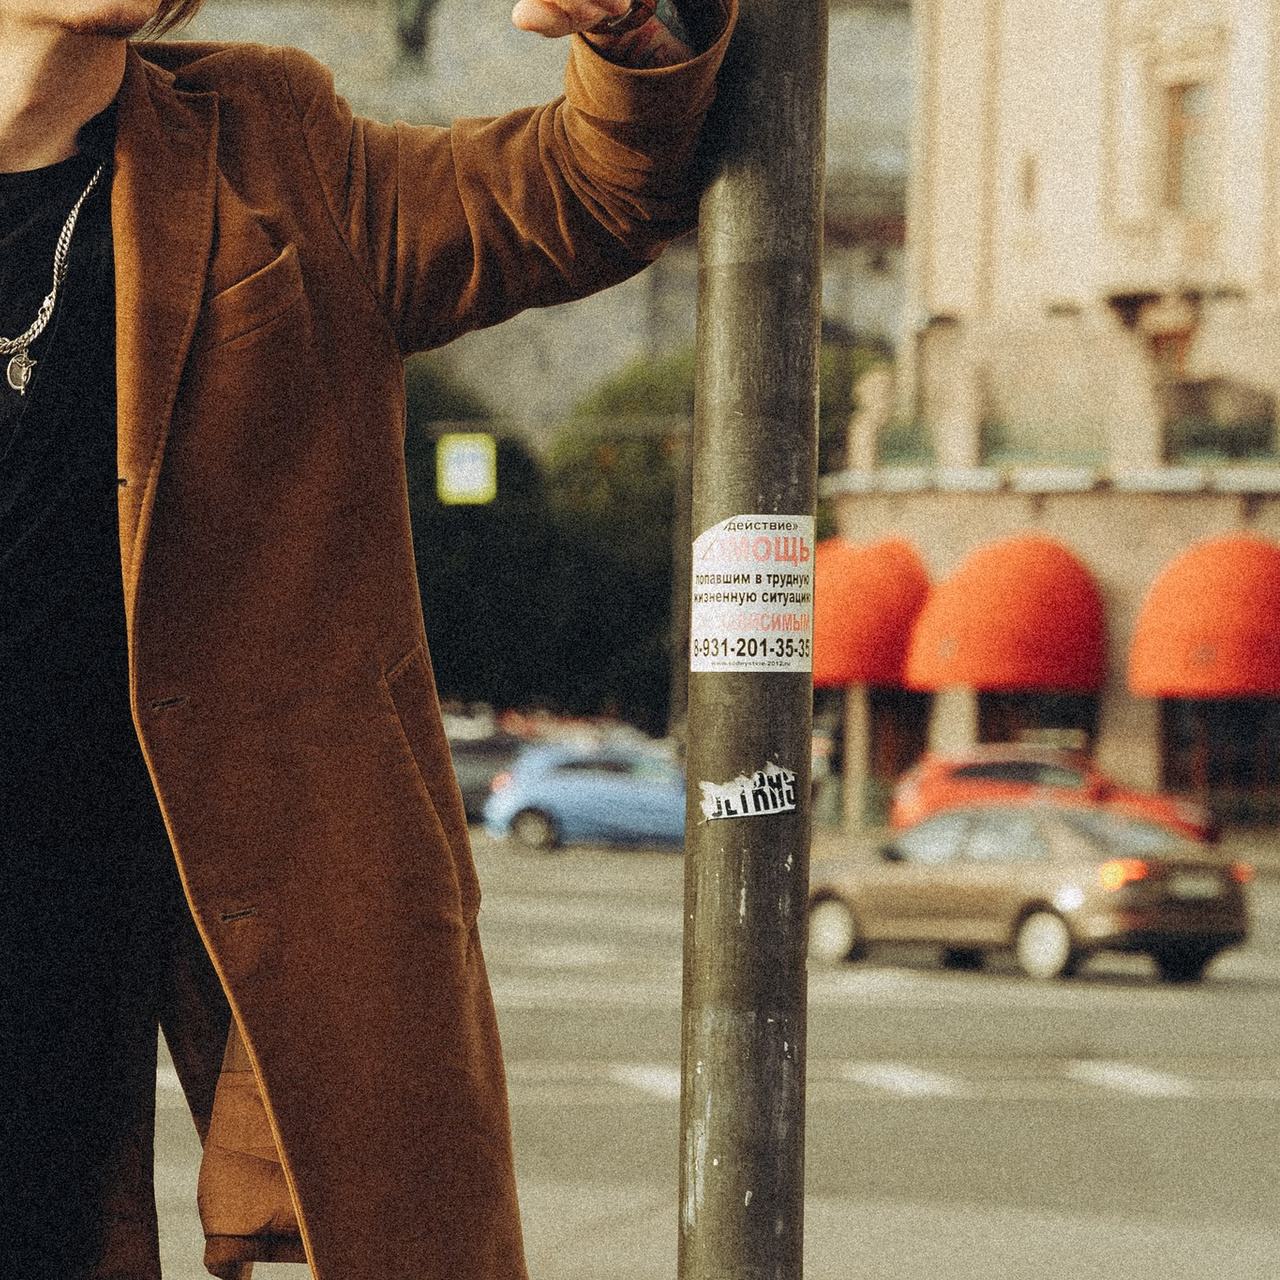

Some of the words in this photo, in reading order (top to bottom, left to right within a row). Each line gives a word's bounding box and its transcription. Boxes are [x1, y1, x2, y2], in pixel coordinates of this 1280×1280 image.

[724, 521, 799, 531] действие»
[755, 574, 762, 584] в
[694, 638, 810, 658] 8-931-201-35-35
